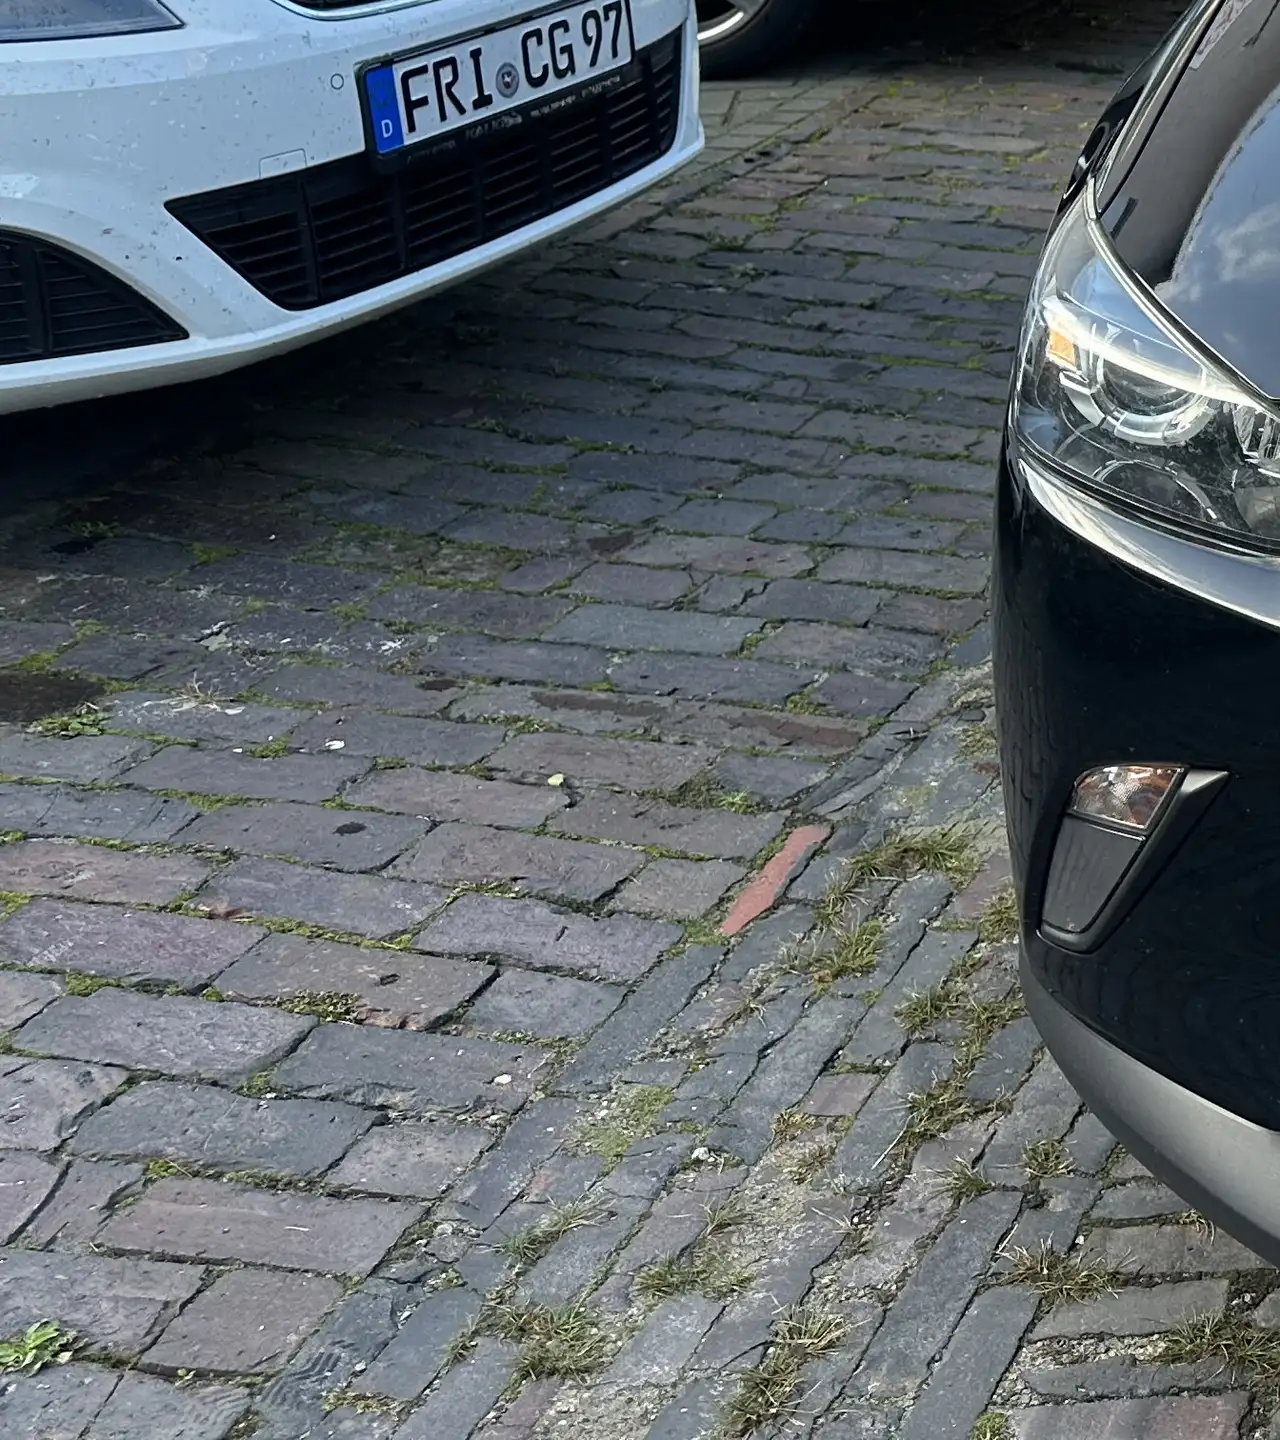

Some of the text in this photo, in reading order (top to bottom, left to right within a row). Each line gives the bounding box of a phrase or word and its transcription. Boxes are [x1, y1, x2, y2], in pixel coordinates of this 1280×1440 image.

[400, 0, 622, 134] FRI CG 97
[381, 119, 393, 138] D
